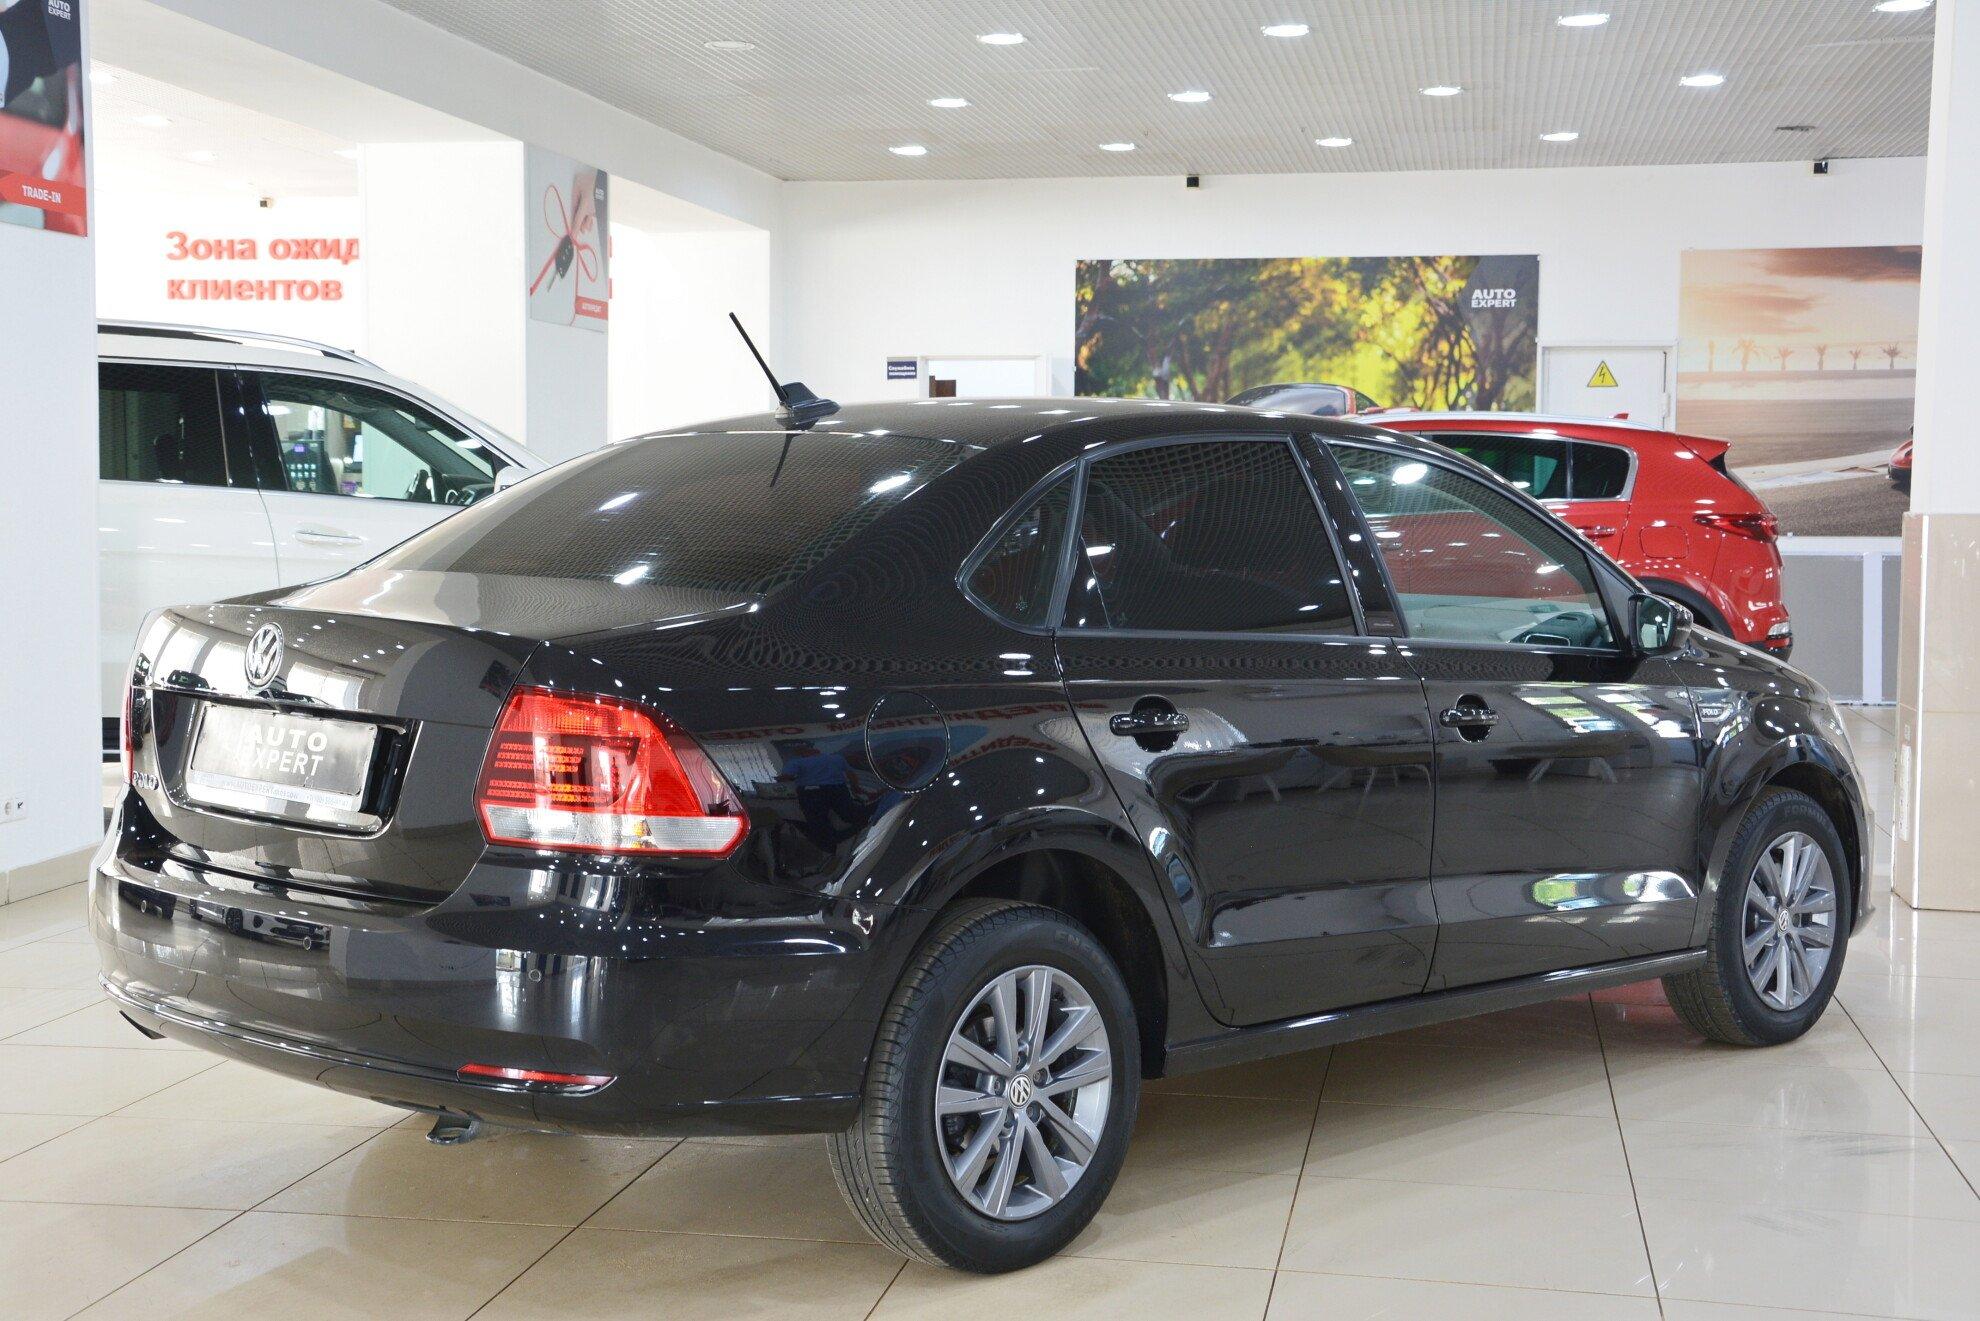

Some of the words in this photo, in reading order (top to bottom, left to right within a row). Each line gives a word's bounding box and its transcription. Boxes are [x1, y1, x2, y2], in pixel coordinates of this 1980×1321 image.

[47, 6, 72, 20] EXPERT
[22, 184, 62, 204] TRADE-IN
[166, 231, 257, 261] Зона
[167, 279, 343, 301] клиентов
[1471, 288, 1517, 300] AUTO
[1471, 299, 1517, 308] EXPERT
[246, 724, 329, 752] AUTO
